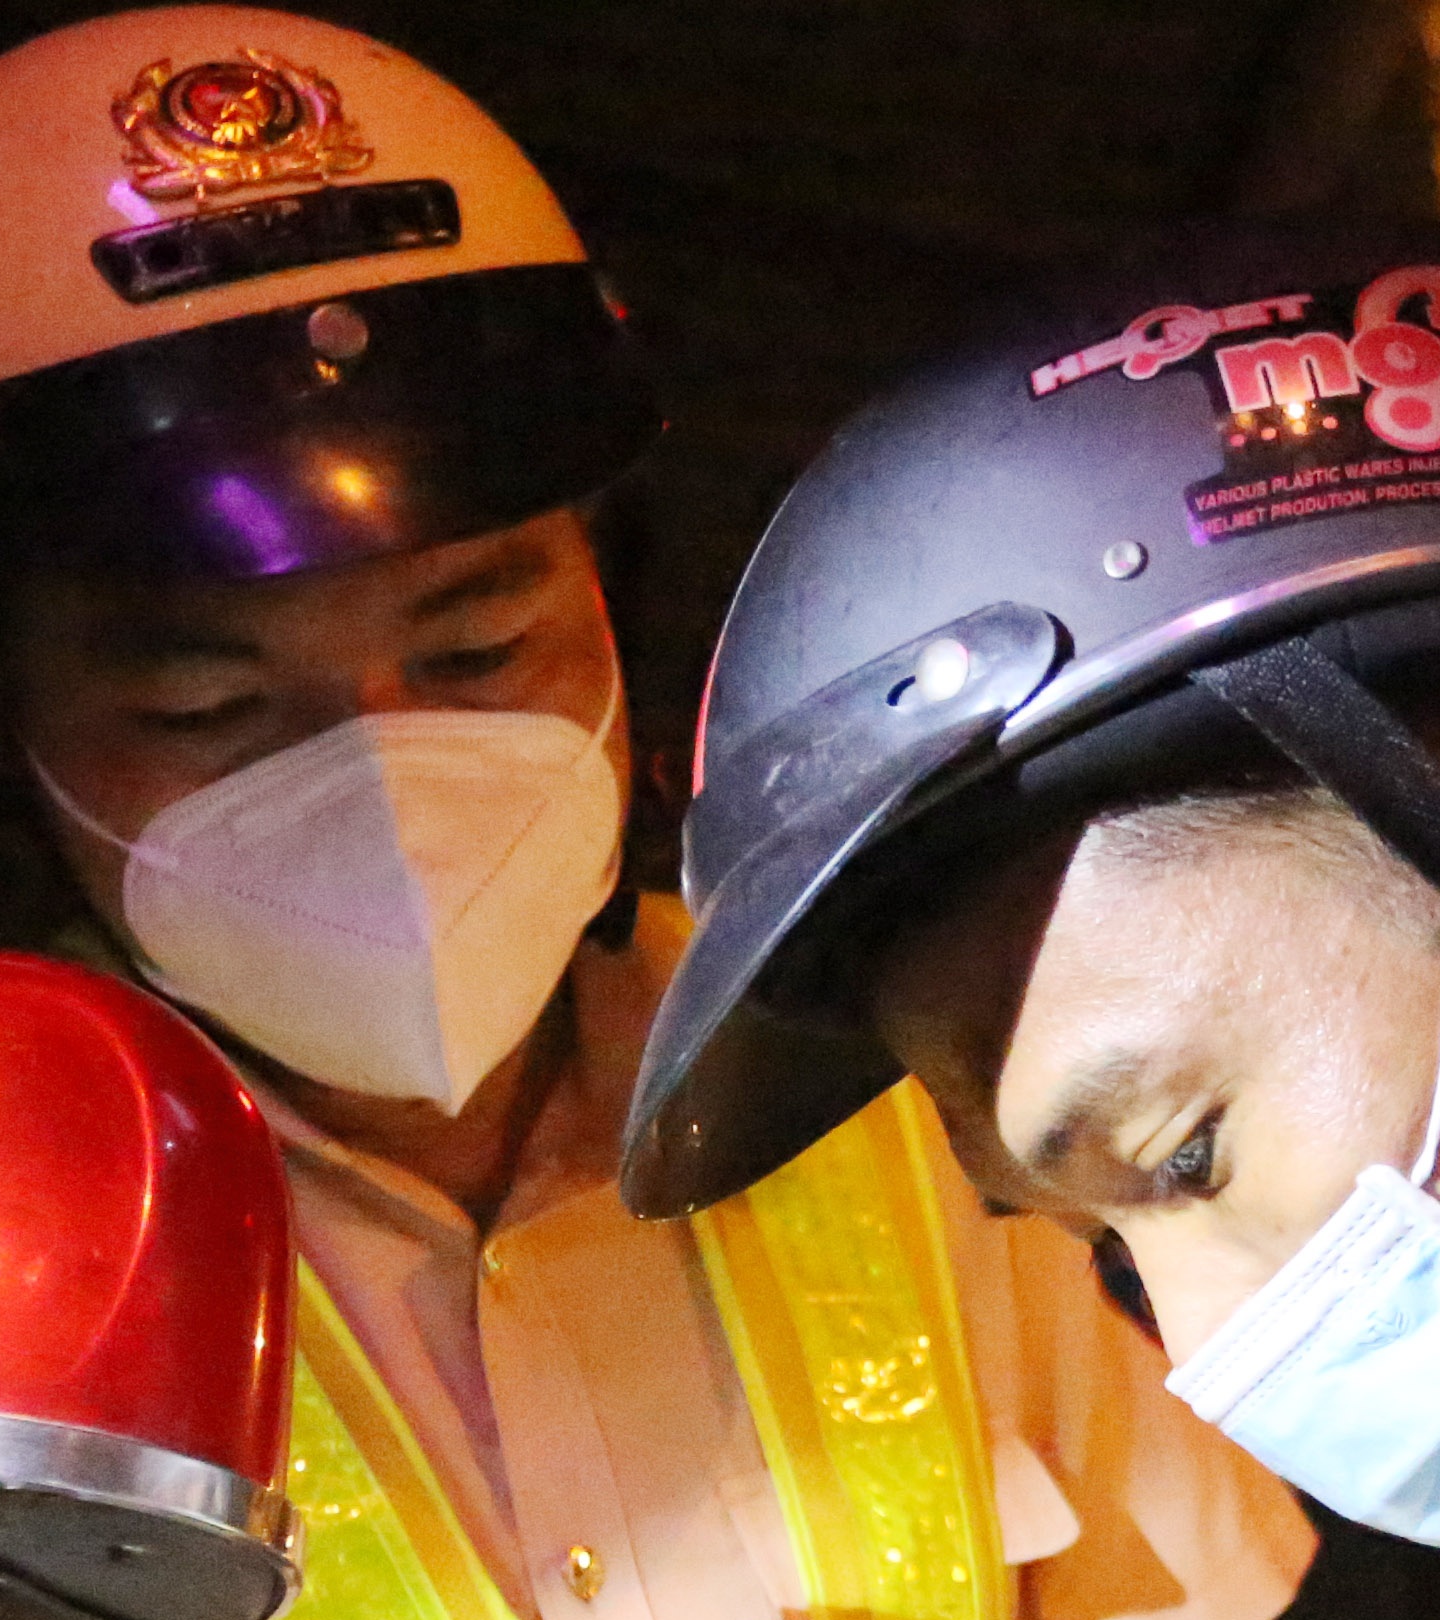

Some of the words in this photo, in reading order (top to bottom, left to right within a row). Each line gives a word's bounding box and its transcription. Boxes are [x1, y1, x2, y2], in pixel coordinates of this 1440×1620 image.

[1194, 480, 1269, 511] VARIOUS
[1271, 466, 1341, 493] PLASTIC
[1344, 458, 1404, 480] WARES
[1202, 506, 1267, 535] HELMET
